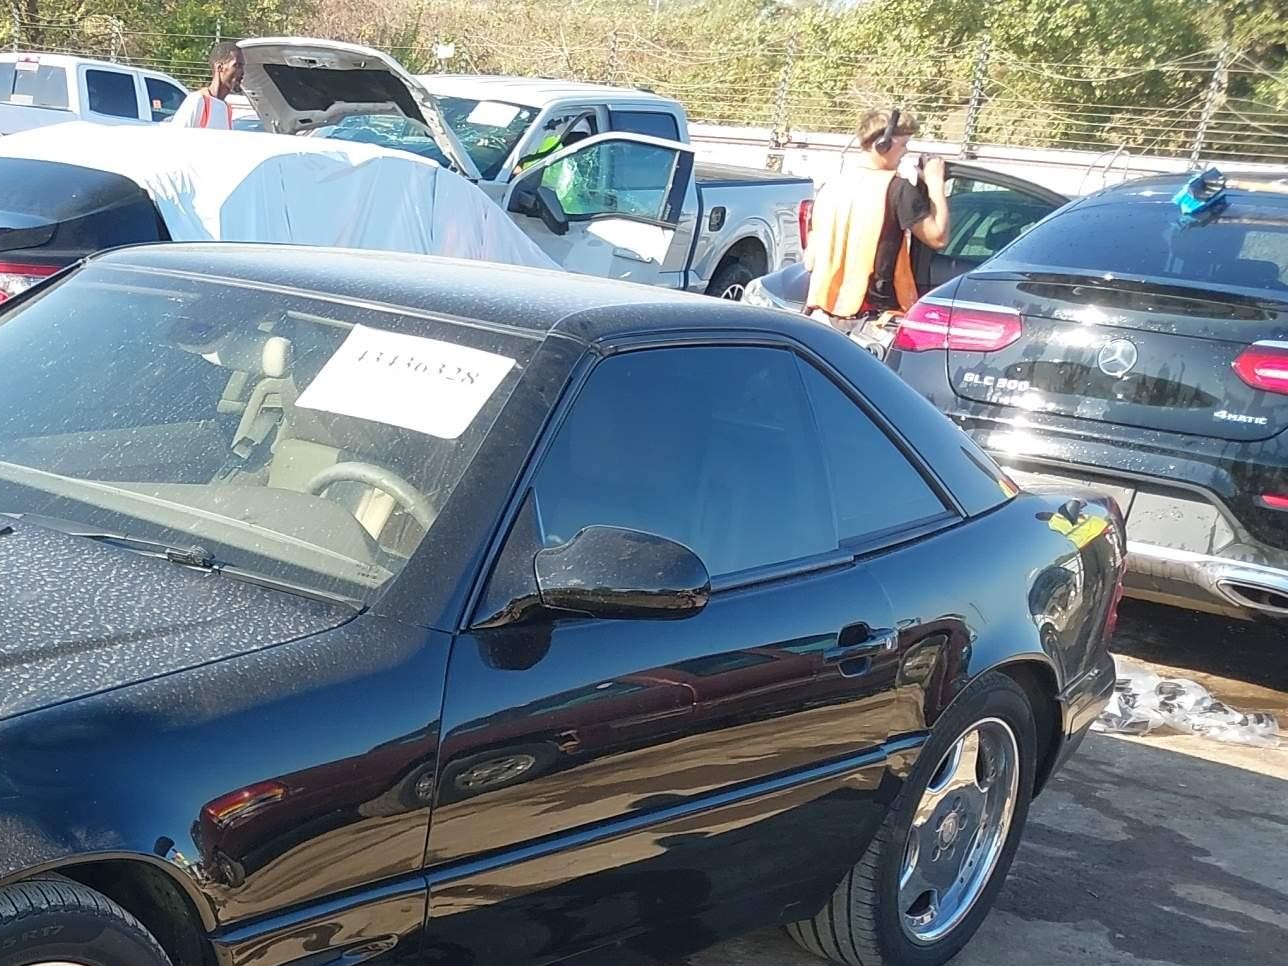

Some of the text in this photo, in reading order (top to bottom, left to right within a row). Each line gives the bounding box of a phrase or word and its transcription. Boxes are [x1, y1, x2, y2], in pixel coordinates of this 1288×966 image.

[963, 372, 1030, 392] GLC 300
[1213, 410, 1269, 425] 4MATIC
